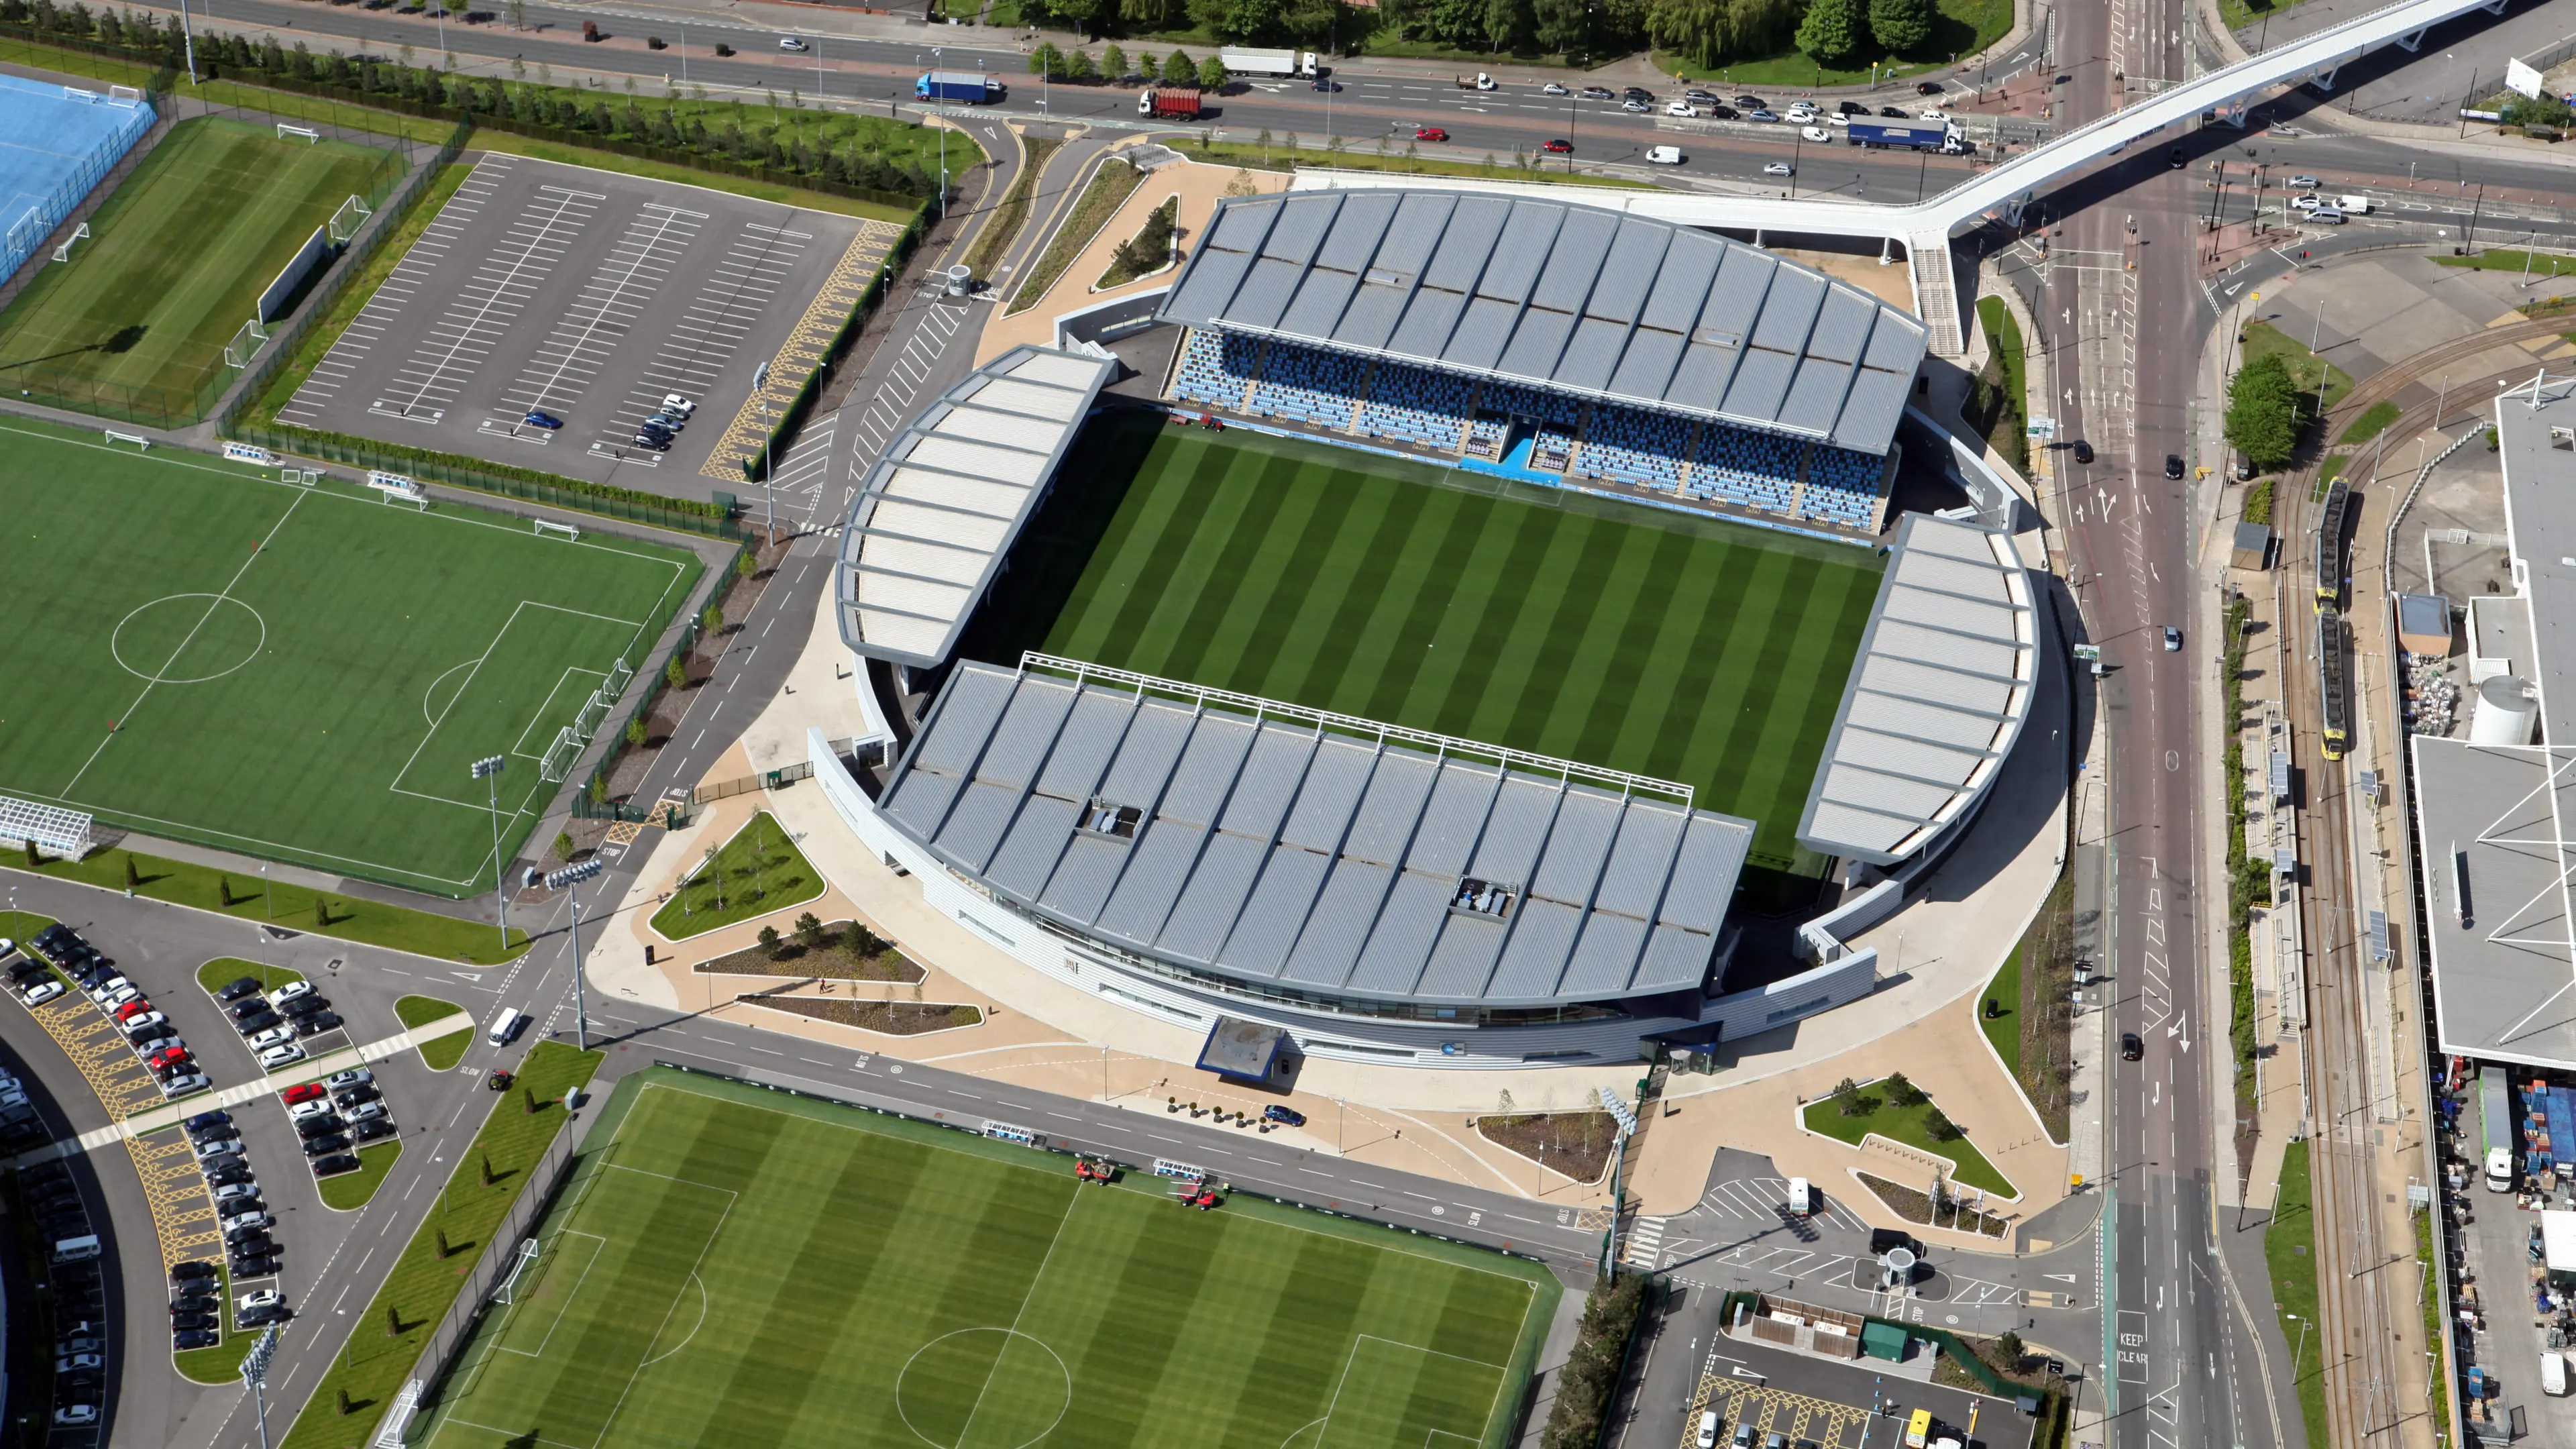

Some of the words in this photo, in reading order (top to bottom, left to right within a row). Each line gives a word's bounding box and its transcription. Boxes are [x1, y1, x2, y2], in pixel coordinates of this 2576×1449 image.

[669, 788, 688, 797] STOP
[602, 847, 621, 857] STOP
[855, 1055, 869, 1069] SLOW
[460, 1066, 480, 1076] SLOW
[1468, 1212, 1481, 1226] SLOW
[1557, 1209, 1570, 1224] STOP
[1912, 1306, 1924, 1322] STOP
[2121, 1333, 2143, 1347] KEEP
[2118, 1350, 2147, 1364] CLEAR
